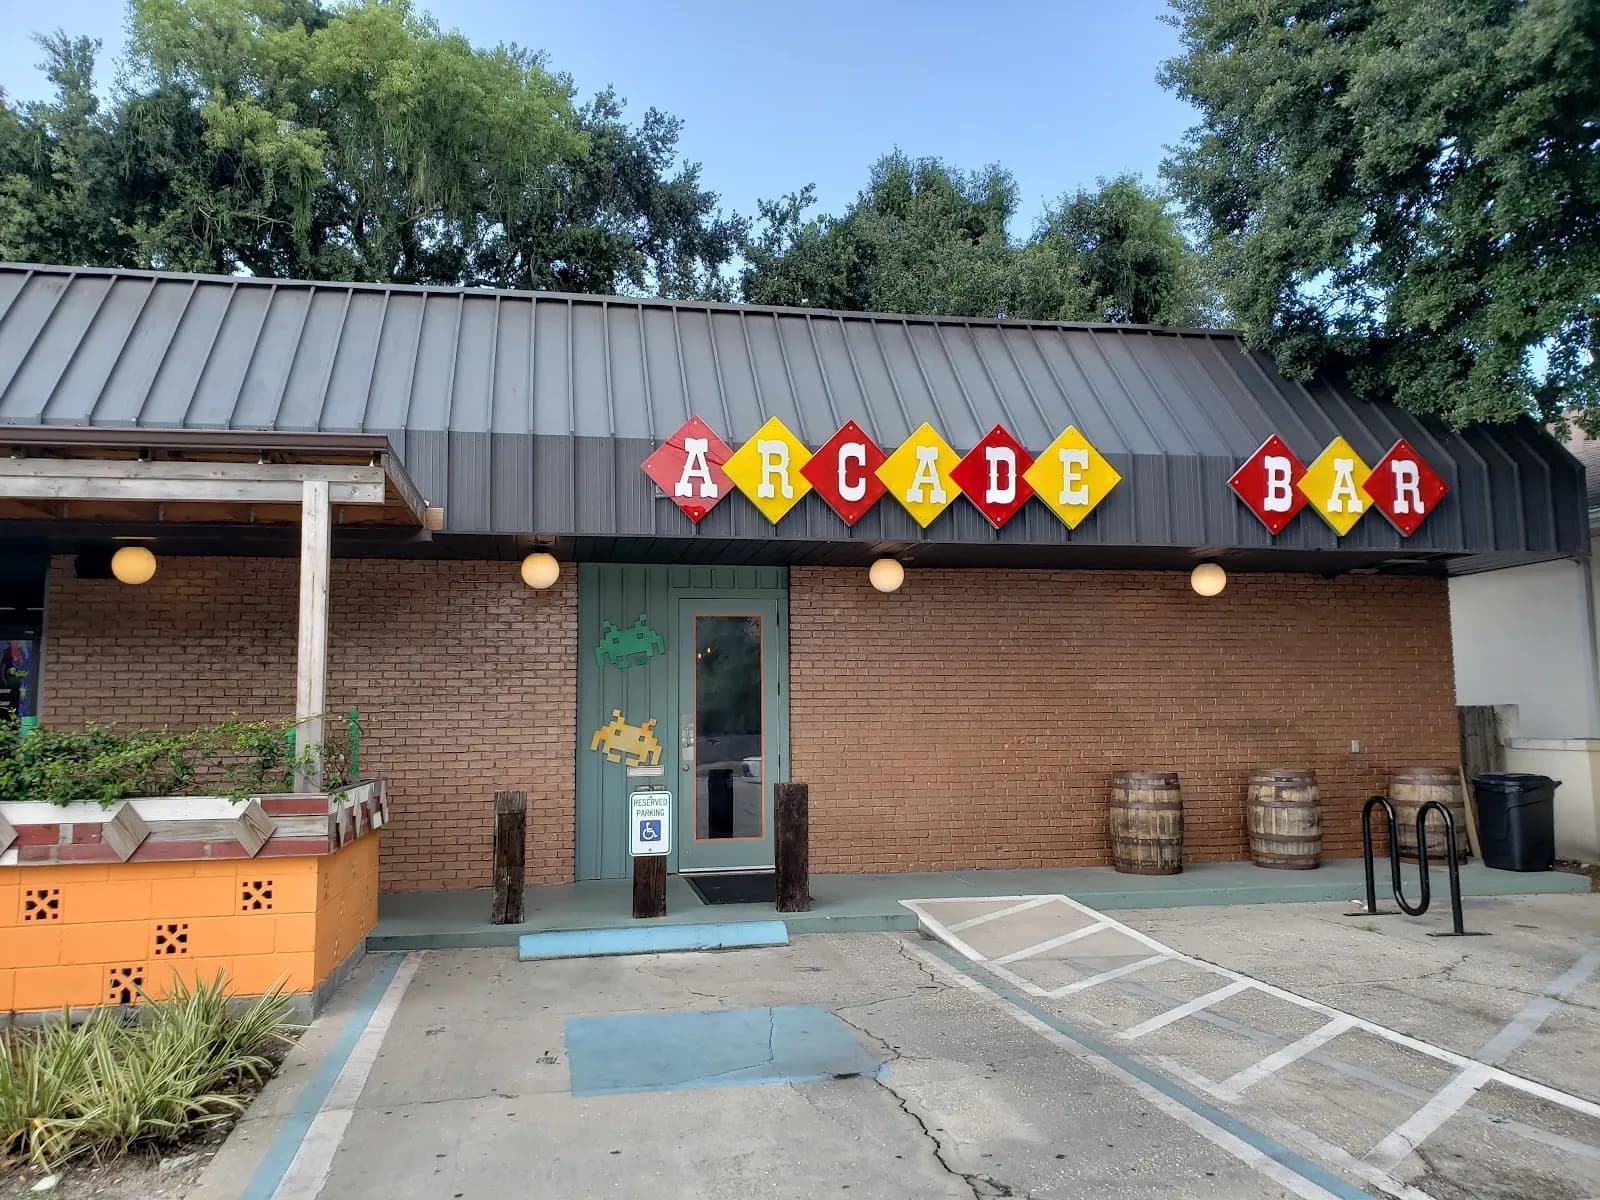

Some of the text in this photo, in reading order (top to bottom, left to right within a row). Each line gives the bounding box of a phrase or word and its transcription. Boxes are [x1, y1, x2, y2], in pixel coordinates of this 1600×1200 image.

[673, 437, 1425, 514] ARCADE BAR
[634, 798, 668, 806] RESERVED
[636, 809, 665, 817] PARKING
